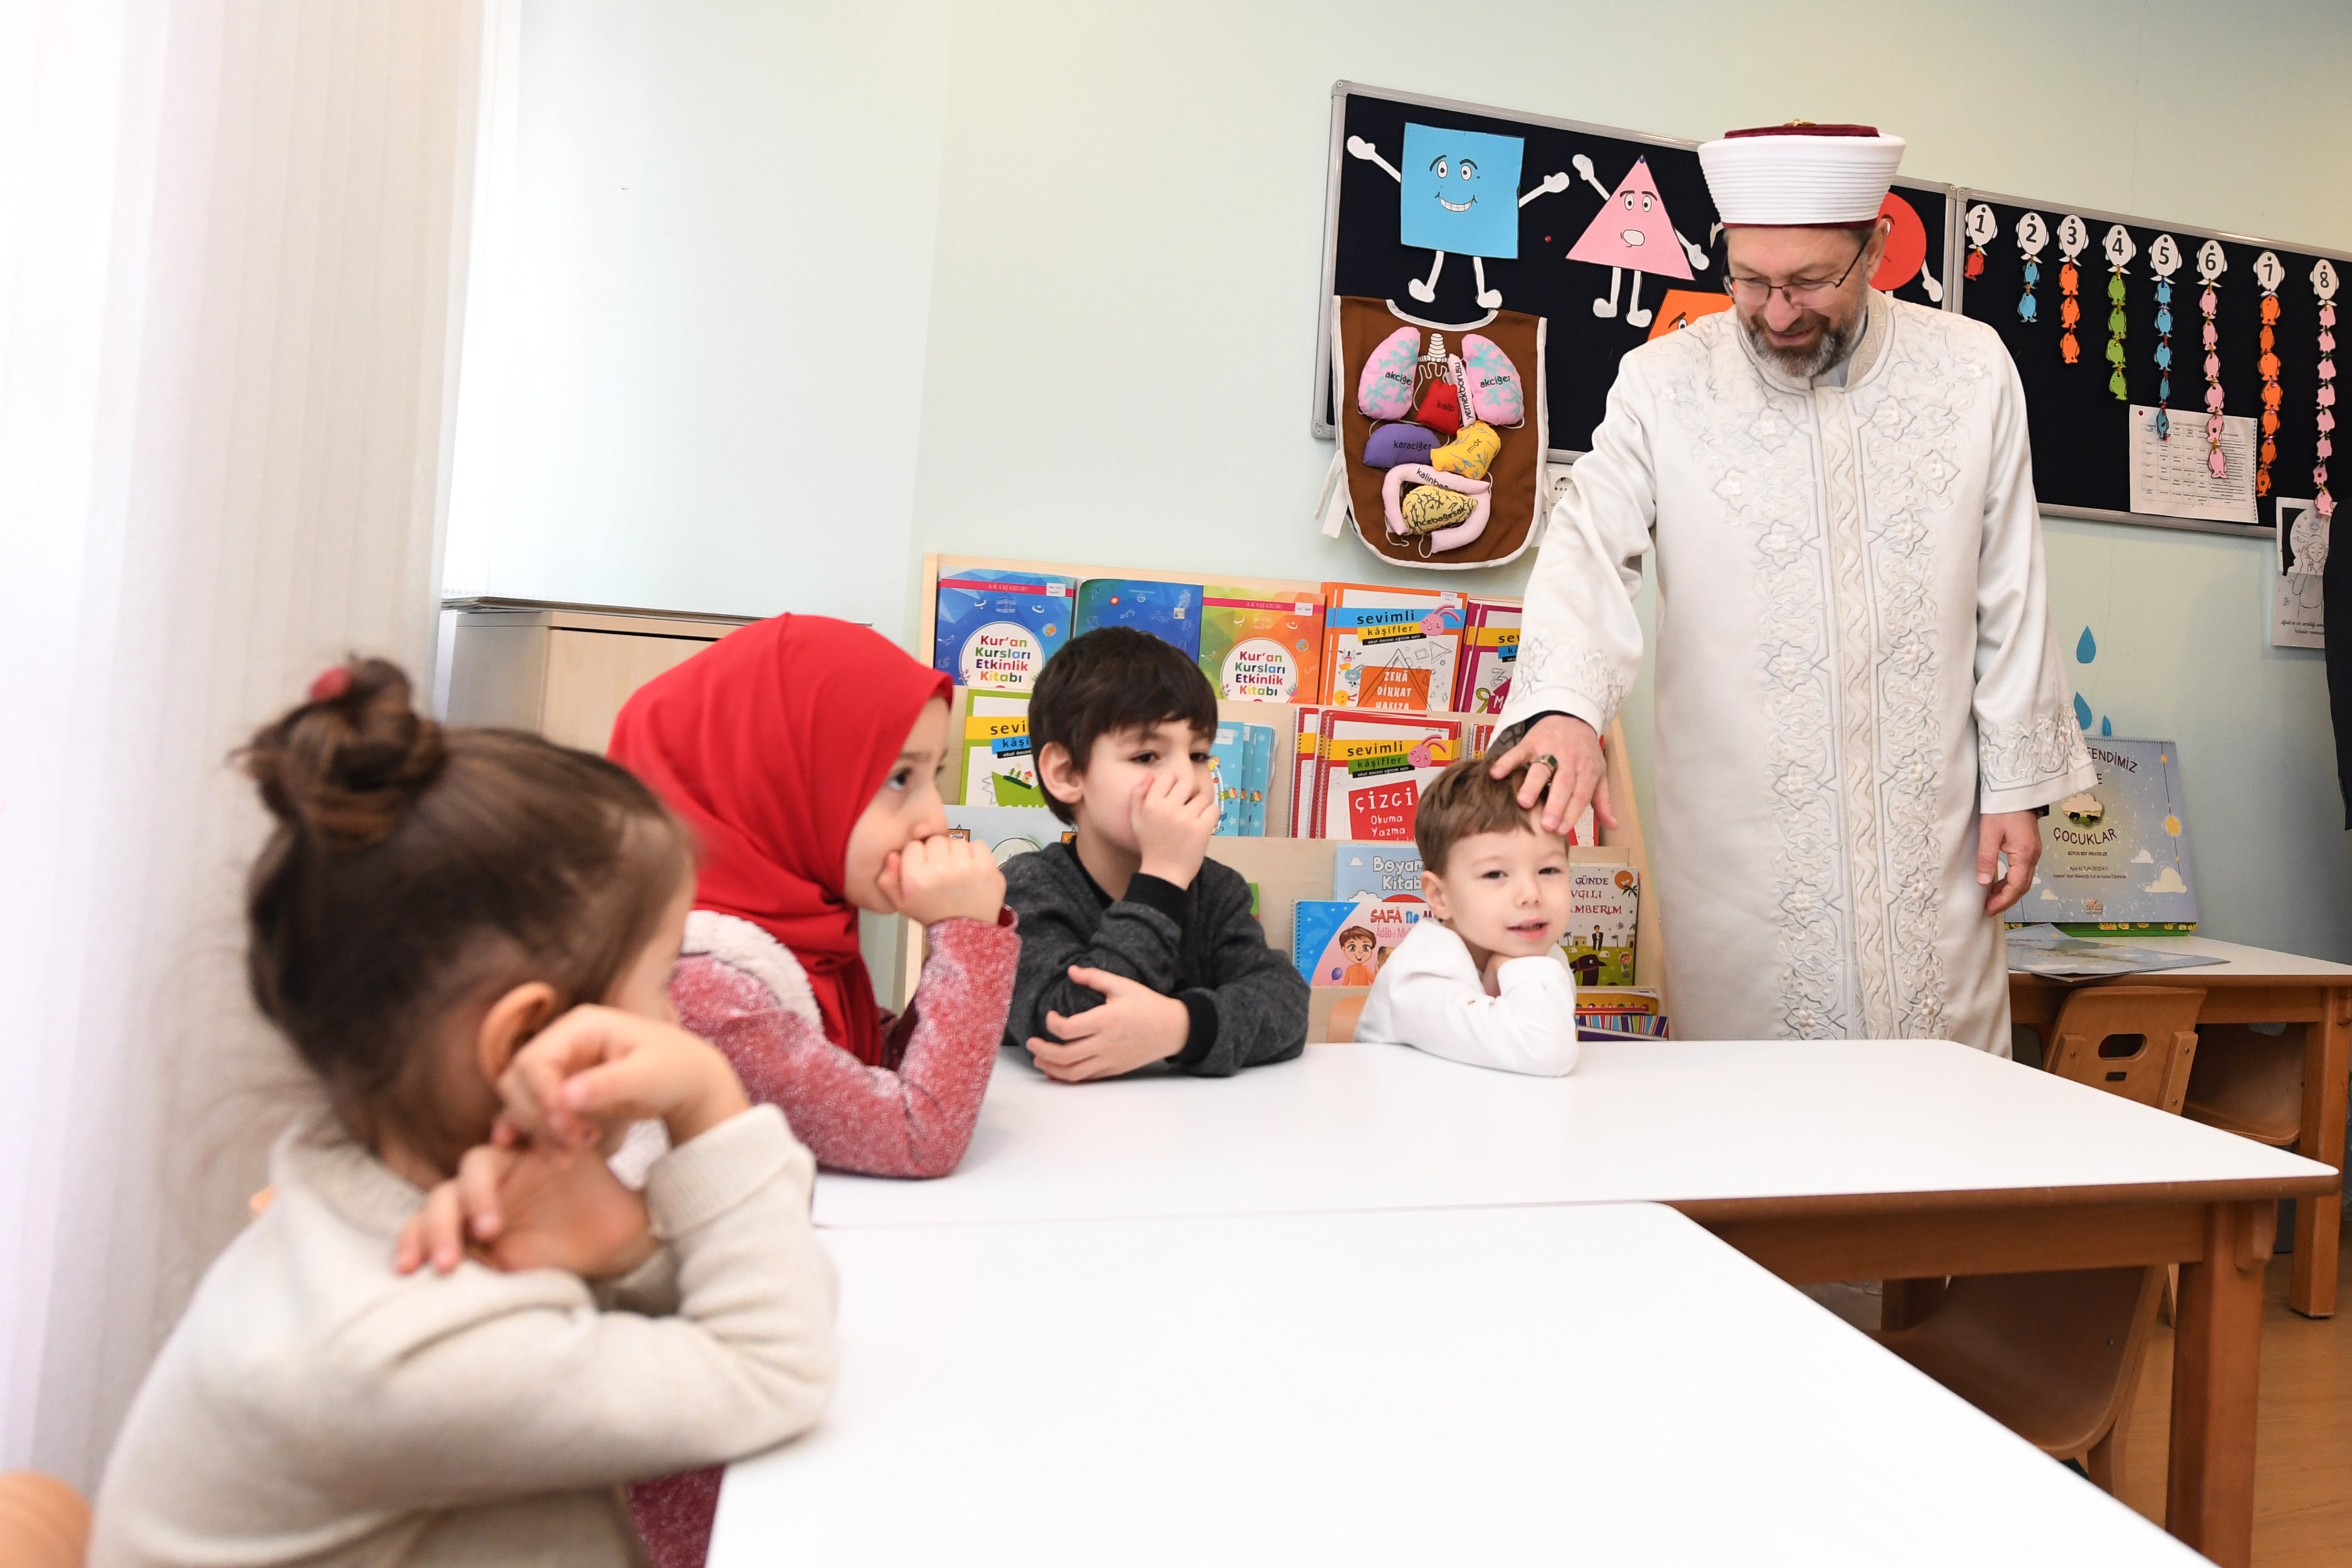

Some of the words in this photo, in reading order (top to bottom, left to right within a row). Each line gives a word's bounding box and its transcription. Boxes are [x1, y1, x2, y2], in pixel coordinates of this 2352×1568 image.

[1974, 215, 1984, 233] 1
[2025, 224, 2037, 242] 2
[2067, 227, 2078, 245] 3
[2111, 237, 2124, 255] 4
[2157, 246, 2169, 265] 5
[2204, 253, 2216, 270] 6
[2262, 264, 2273, 282] 7
[2319, 272, 2328, 288] 8
[1454, 362, 1474, 420] yemekborusu
[1437, 401, 1454, 412] kalp
[1393, 440, 1432, 451] karaciğer
[1467, 439, 1482, 454] mide
[1357, 610, 1414, 625] sevimli
[1368, 625, 1413, 637] kâşifler
[975, 647, 1031, 660] Kursları
[976, 659, 1028, 671] Etkinlik
[1235, 662, 1285, 674] Kursları
[980, 671, 1022, 683] Kitabı
[1236, 673, 1283, 685] Etkinlik
[1240, 685, 1277, 696] Kitabı
[1377, 684, 1412, 697] DİKKAT
[990, 721, 1026, 735] sevi
[1003, 737, 1030, 748] kâşi
[1347, 741, 1403, 757] sevimli
[1357, 756, 1402, 768] kâşifler
[2087, 746, 2138, 773] ENDİMİZ
[2096, 773, 2103, 785] E
[1355, 787, 1413, 813] ÇİZGİ
[1371, 815, 1403, 825] Okuma
[1371, 827, 1406, 837] Yazma
[2053, 827, 2117, 846] ÇOCUKLAR
[1382, 875, 1422, 891] Kitab
[1575, 875, 1609, 886] GÜNDE
[1570, 889, 1601, 900] VGİLİ
[1370, 907, 1402, 923] SAFÂ
